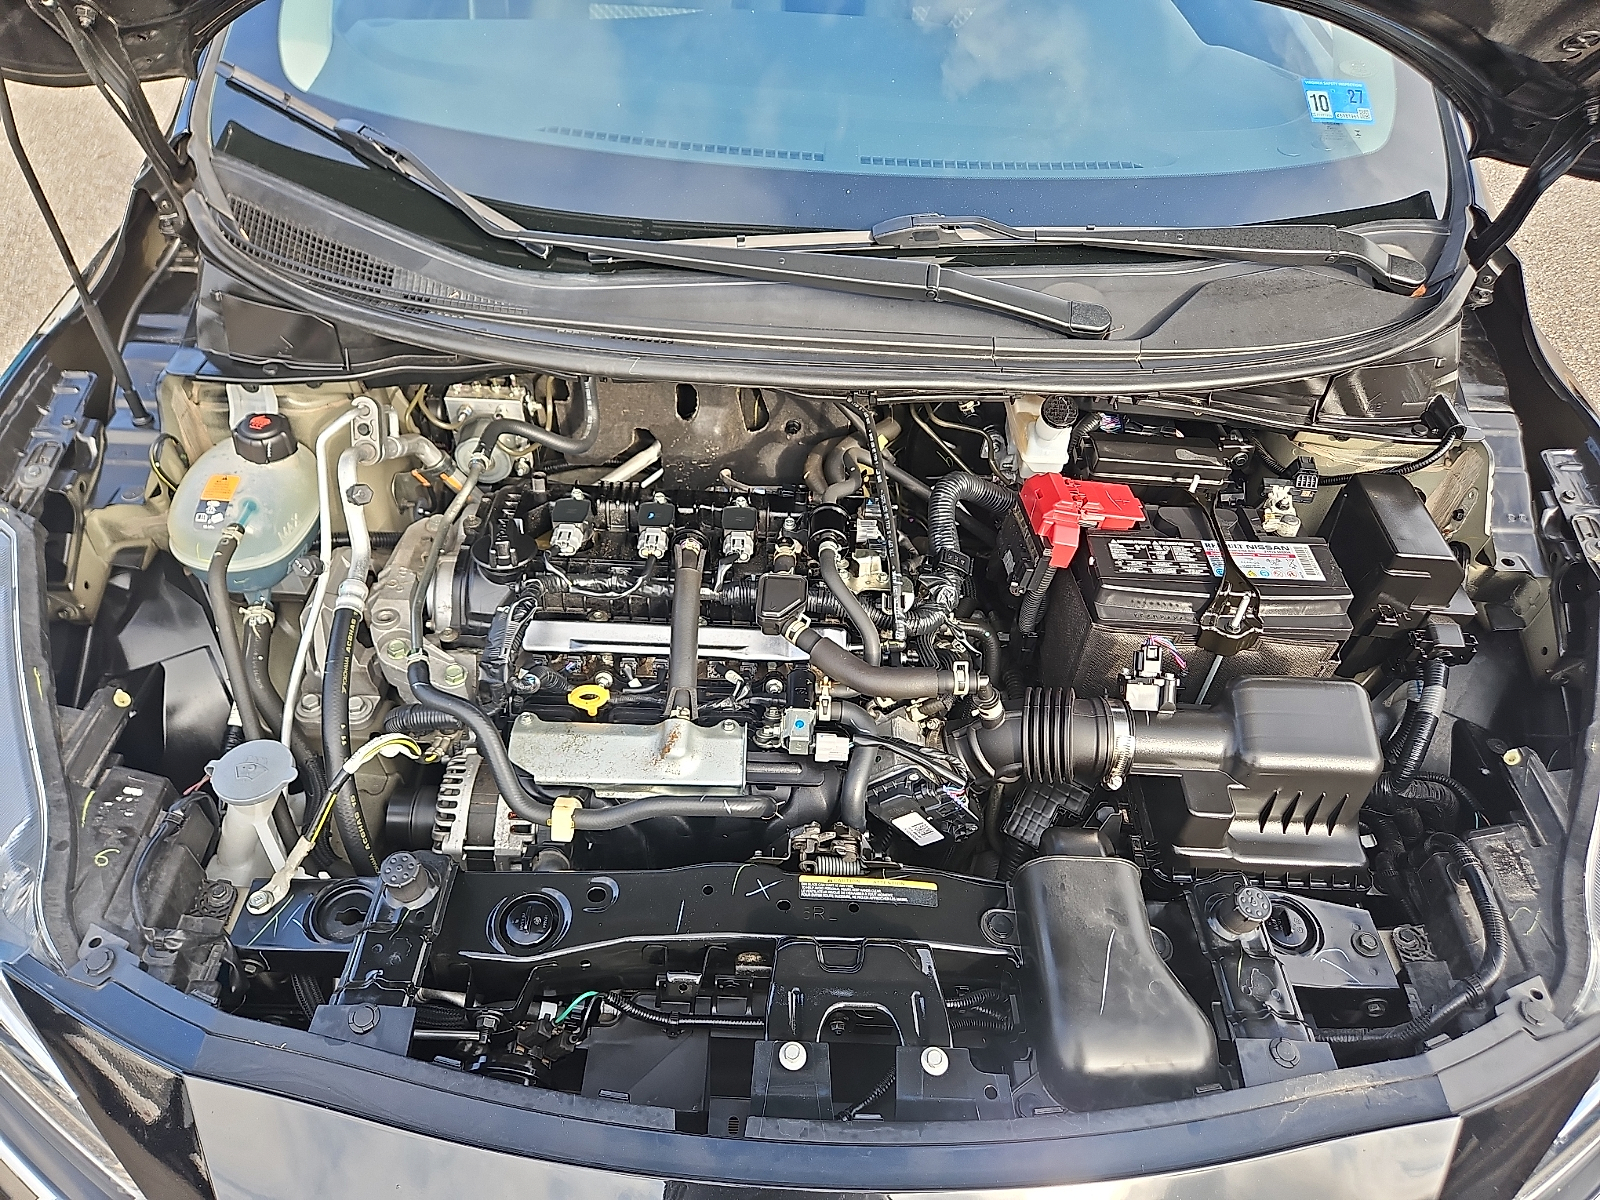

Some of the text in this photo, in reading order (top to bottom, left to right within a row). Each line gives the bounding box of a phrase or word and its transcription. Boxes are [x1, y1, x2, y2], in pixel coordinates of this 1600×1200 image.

[1309, 94, 1330, 112] 10
[1347, 89, 1363, 104] 27
[1246, 543, 1290, 551] NISSAN
